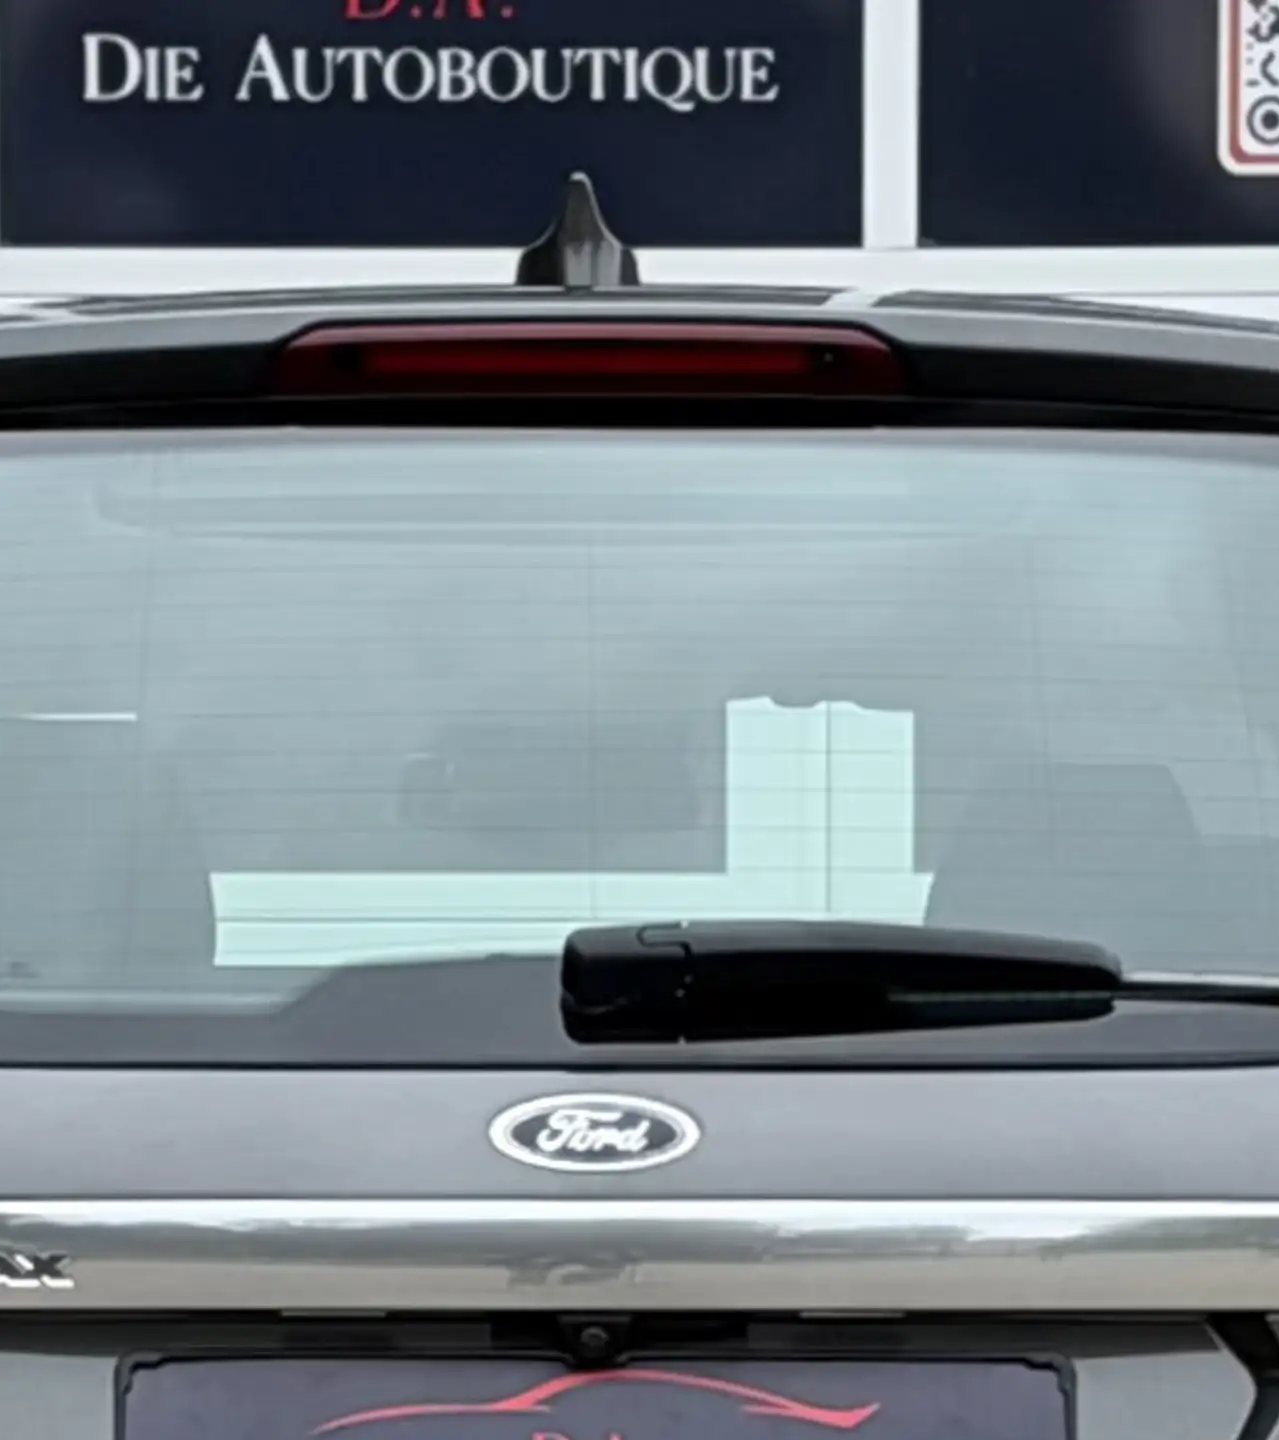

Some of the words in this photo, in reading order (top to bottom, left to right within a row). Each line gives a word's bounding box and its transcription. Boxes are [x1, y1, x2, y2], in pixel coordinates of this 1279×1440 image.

[83, 33, 204, 102] DIE
[236, 34, 779, 112] AUTOBOUTIQUE
[536, 1108, 651, 1152] Ford
